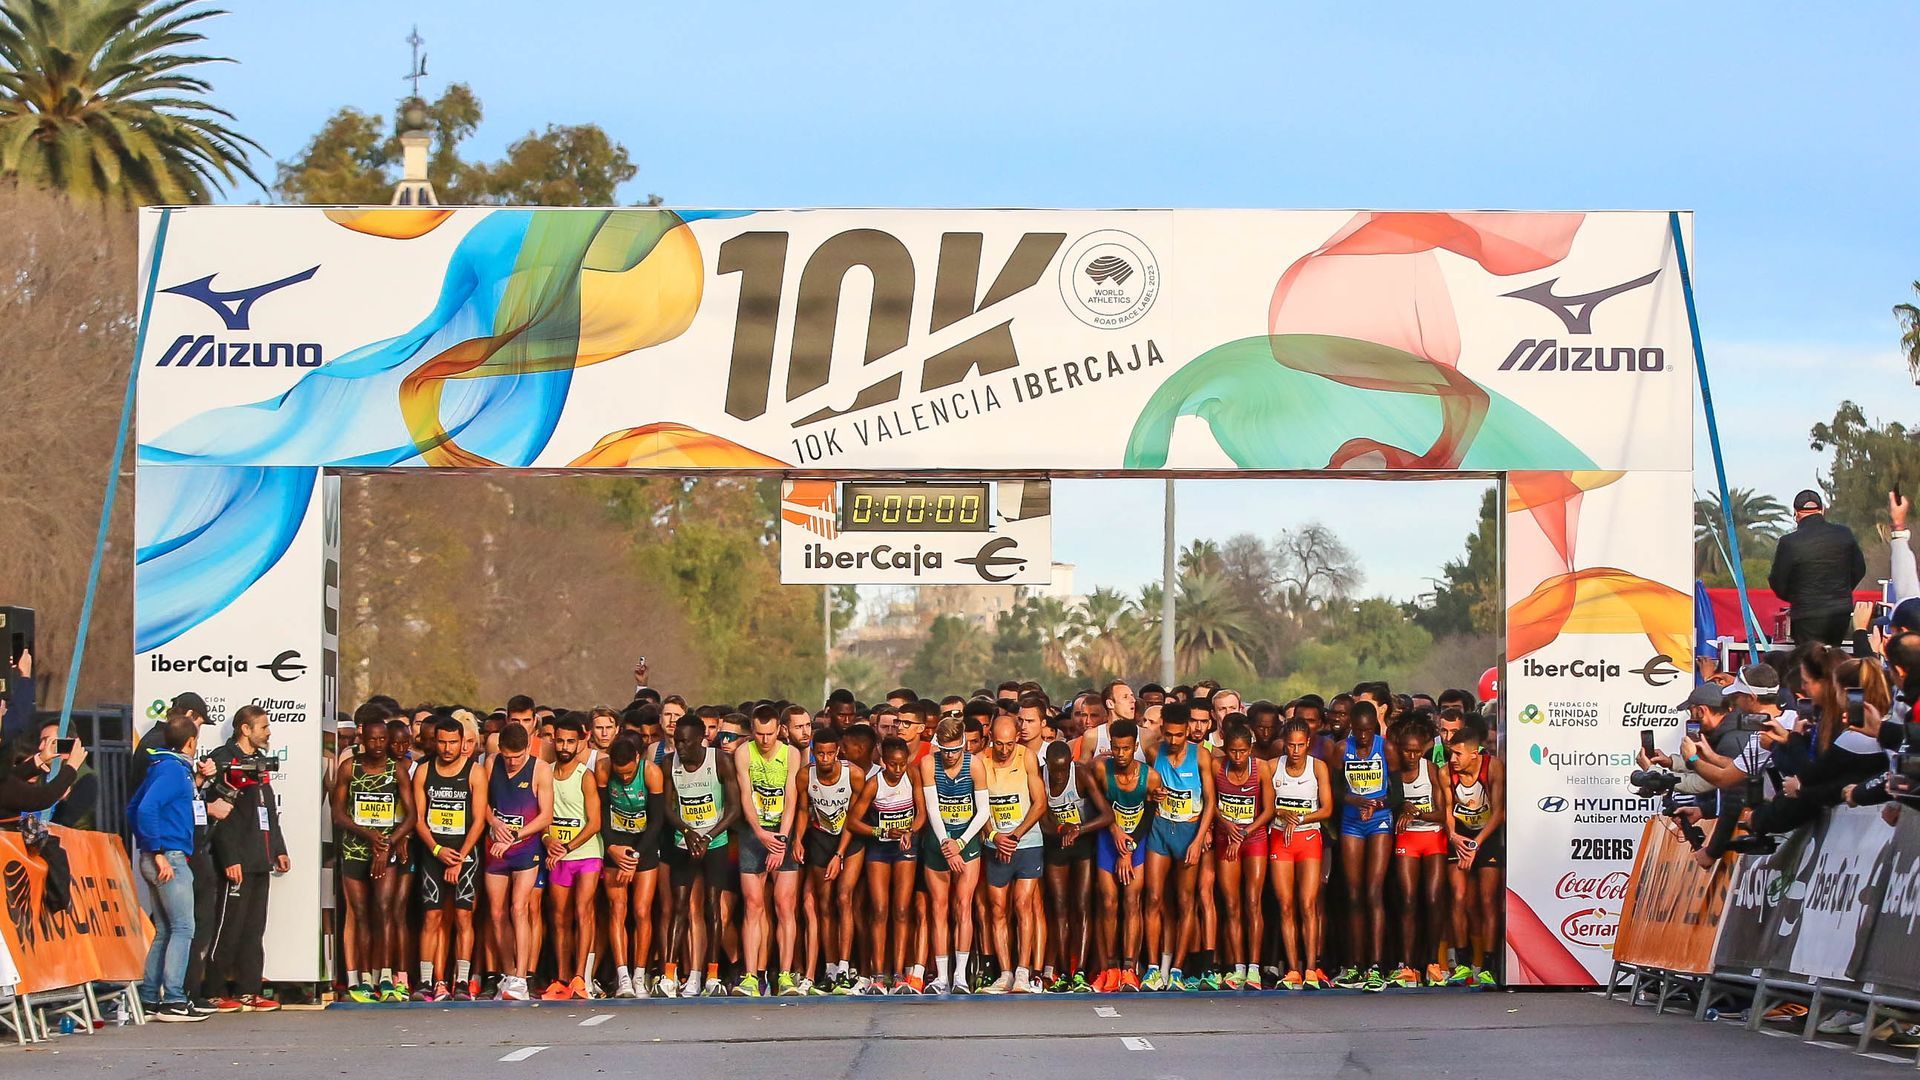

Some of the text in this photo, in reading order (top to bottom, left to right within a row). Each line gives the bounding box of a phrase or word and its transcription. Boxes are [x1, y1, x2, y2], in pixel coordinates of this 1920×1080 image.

[1094, 317, 1117, 325] ROAD
[1118, 309, 1139, 324] RACE
[1138, 288, 1155, 312] LABEL
[717, 228, 1067, 428] 10K
[156, 335, 323, 368] MIZUNO
[1497, 339, 1664, 372] MIZUNO
[791, 339, 1165, 465] 10K VALENCIA IBERCAJA
[852, 494, 980, 523] 0:00:00
[804, 543, 942, 577] iberCaja
[151, 654, 248, 678] iberCaja
[1523, 659, 1620, 682] iberCaja
[1549, 709, 1598, 718] TRINIDAD
[1623, 702, 1668, 714] Cultura
[1549, 718, 1598, 727] ALFONSO
[1622, 714, 1679, 727] Esfuerzo
[1549, 750, 1637, 771] quirónsal
[1349, 771, 1382, 782] BIRUNDU
[1566, 775, 1621, 785] Healthcare
[360, 803, 392, 812] LANGAT
[814, 797, 849, 807] NGLAND
[938, 804, 972, 813] GRESSIER
[1574, 798, 1655, 811] HYUNDAI
[685, 804, 712, 815] LOBALU
[1222, 803, 1253, 815] TESHALE
[621, 817, 636, 828] 76
[1574, 813, 1651, 824] Autiber Moto
[557, 829, 571, 841] 371
[1571, 838, 1634, 860] 226ERS
[1555, 871, 1630, 900] Coca-Col
